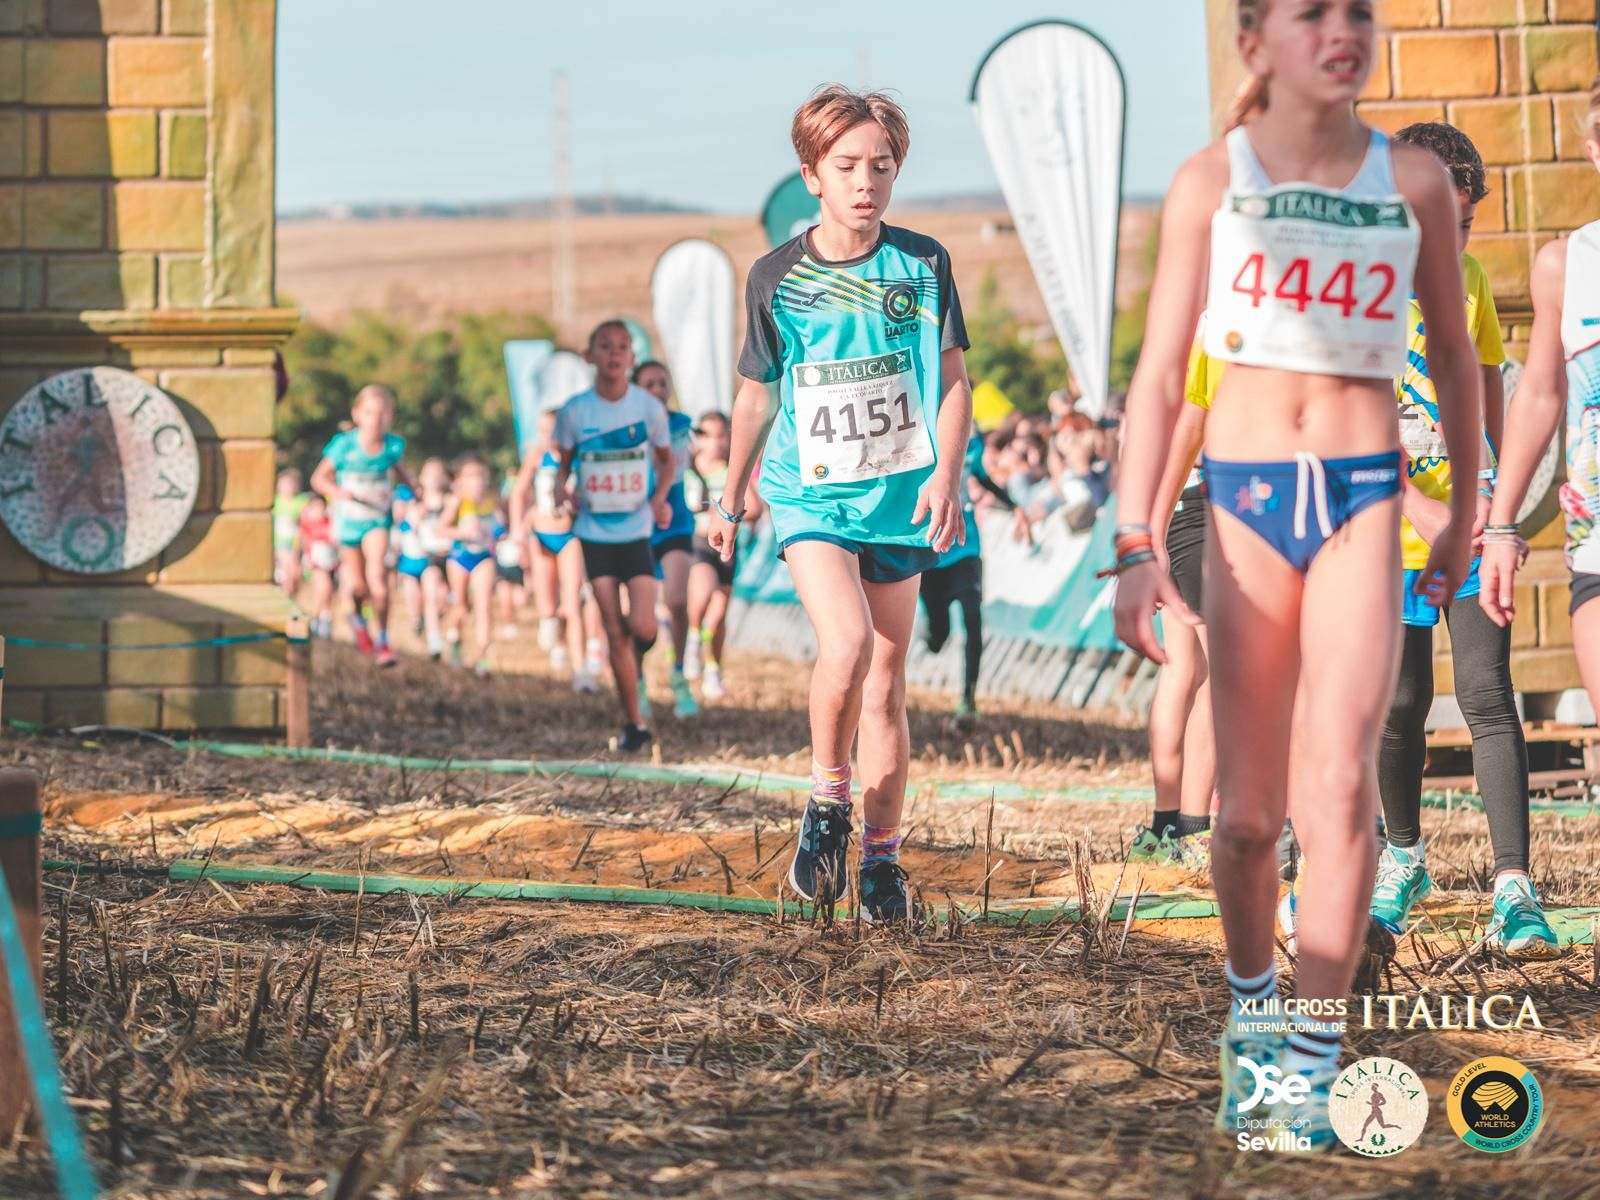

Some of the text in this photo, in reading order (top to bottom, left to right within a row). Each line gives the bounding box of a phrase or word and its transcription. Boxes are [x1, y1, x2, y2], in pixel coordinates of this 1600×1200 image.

[1231, 253, 1396, 321] 4442
[809, 391, 917, 444] 4151
[586, 472, 643, 494] 4418
